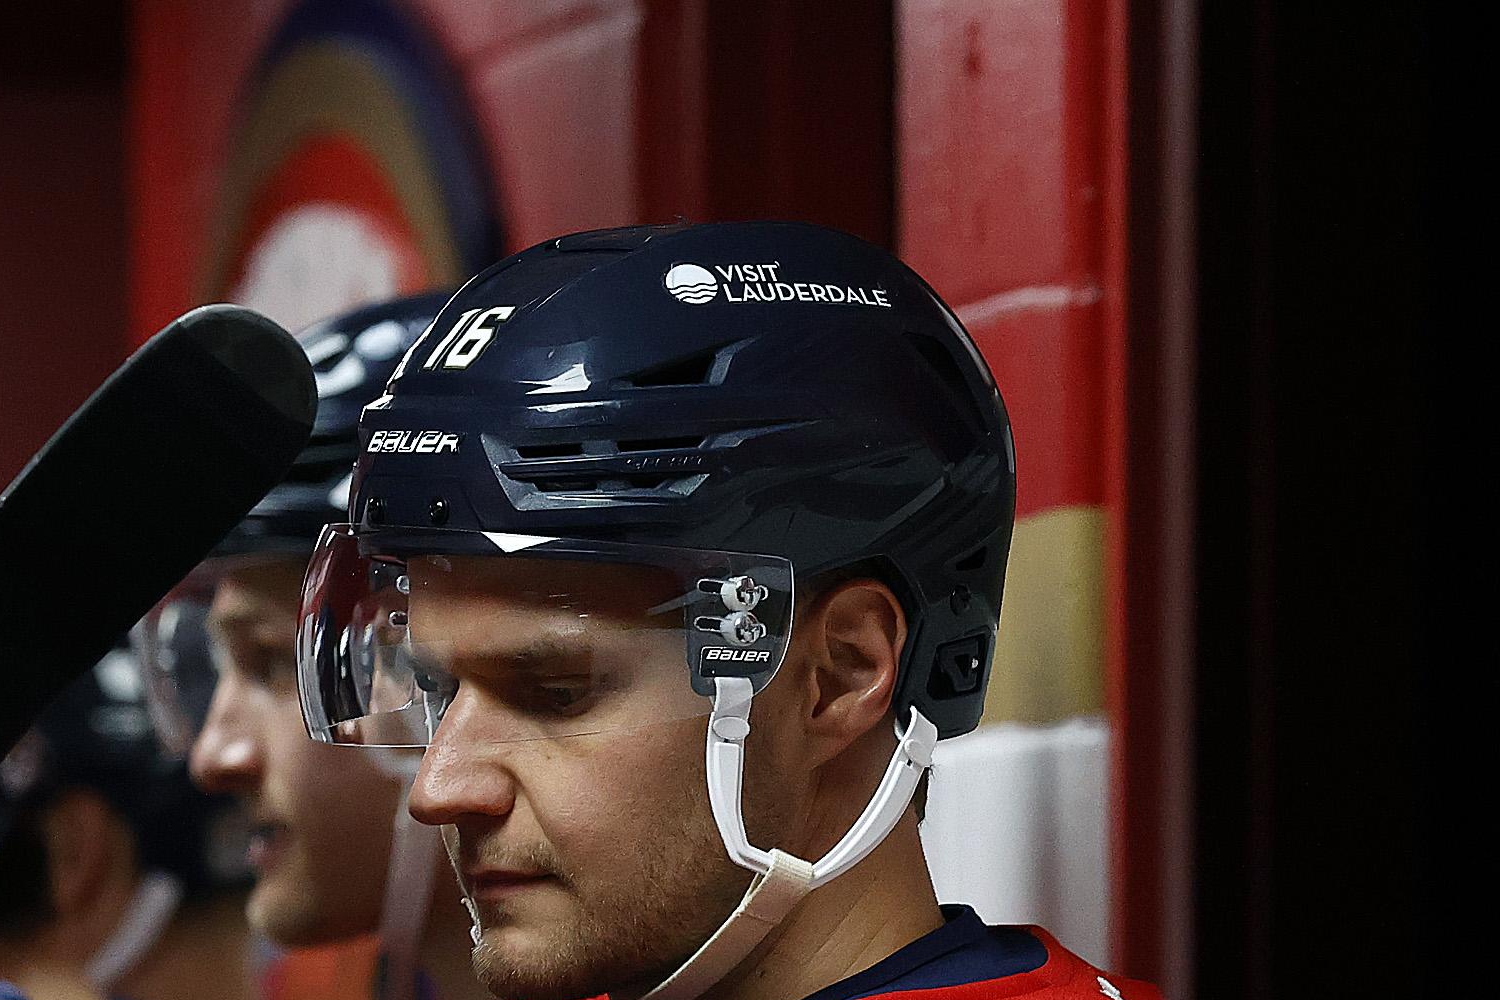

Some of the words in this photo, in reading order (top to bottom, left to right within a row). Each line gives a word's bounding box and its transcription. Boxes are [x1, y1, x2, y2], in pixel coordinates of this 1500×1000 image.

[714, 263, 778, 283] VISIT
[722, 281, 892, 308] LAUDERDALE
[422, 306, 516, 371] 16
[366, 430, 461, 454] BAUER
[705, 649, 770, 662] BAUER
